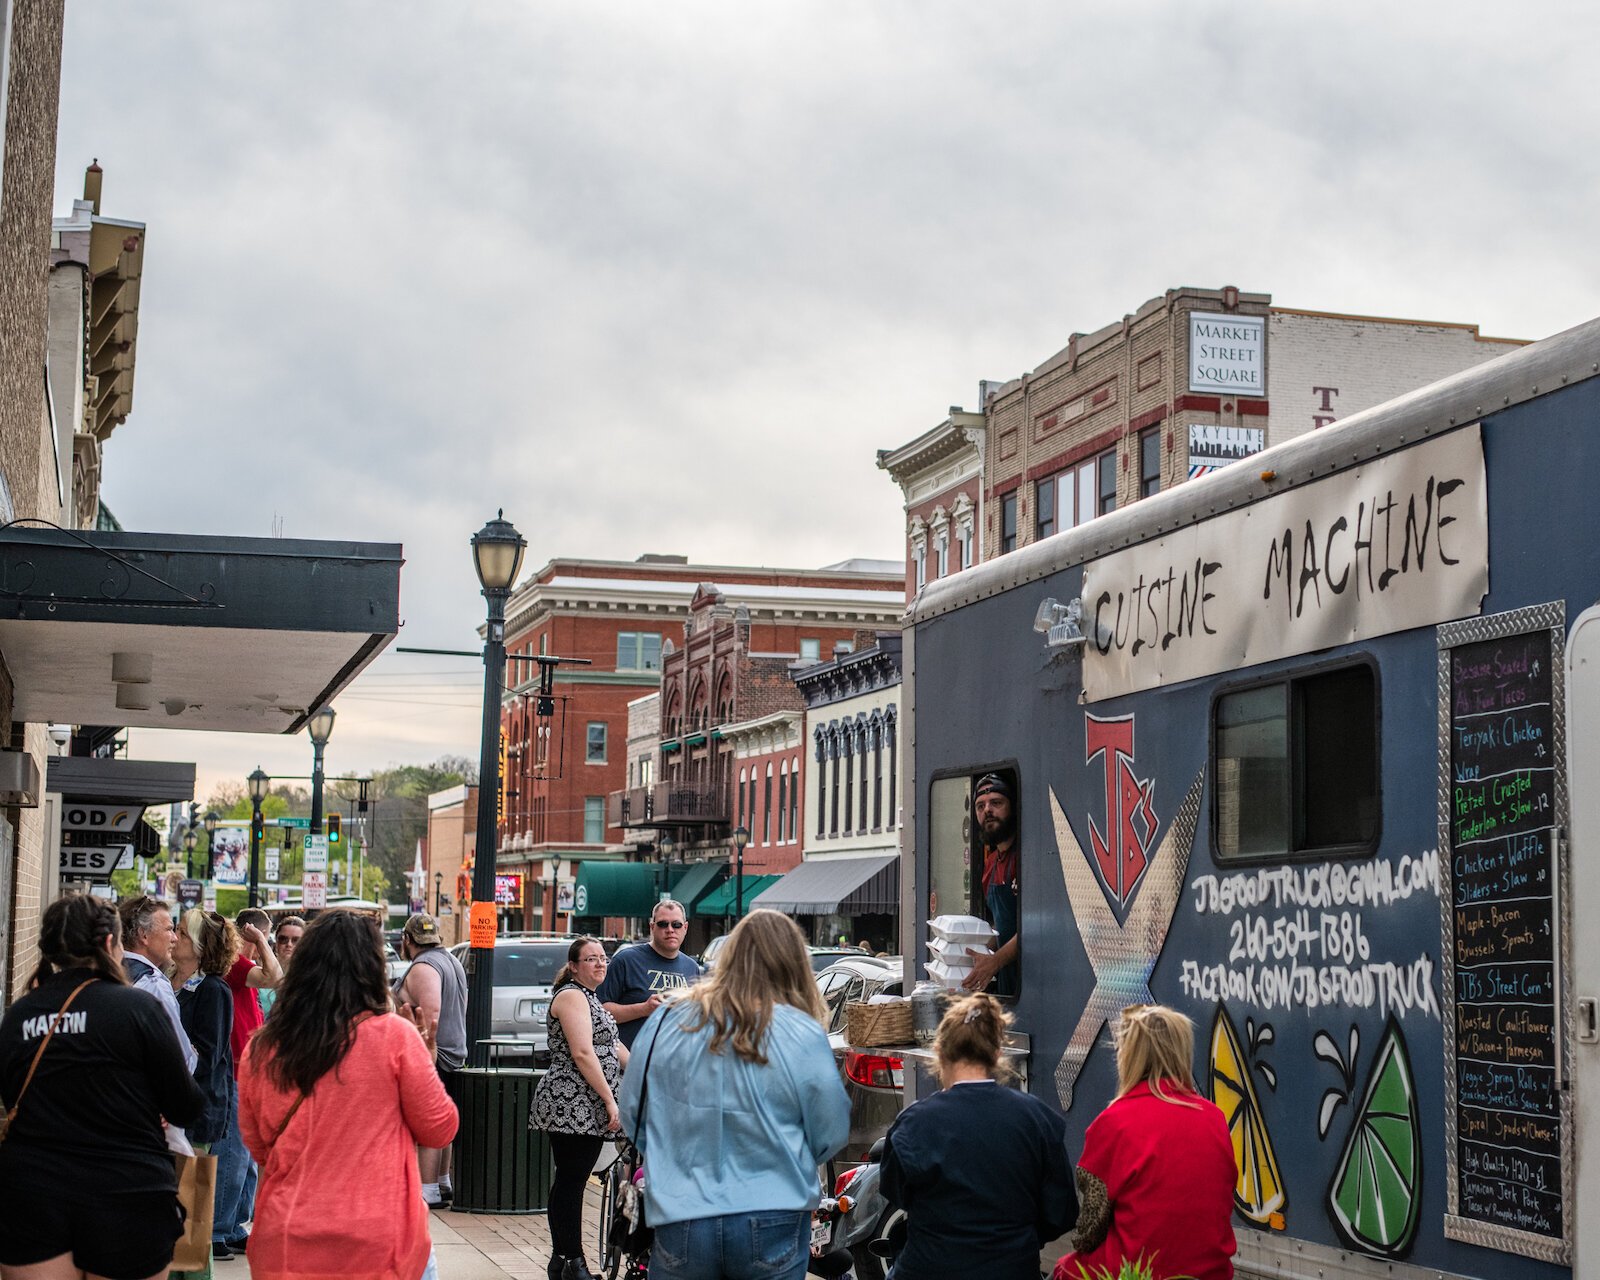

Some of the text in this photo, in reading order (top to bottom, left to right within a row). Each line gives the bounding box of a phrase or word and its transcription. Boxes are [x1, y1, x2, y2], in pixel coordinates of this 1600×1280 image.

[1195, 323, 1260, 341] MARKET
[1199, 344, 1255, 362] STREET
[1197, 365, 1258, 384] SQUARE
[1191, 424, 1263, 443] SKYLINE
[1095, 475, 1465, 657] CUISINE MACHINE
[1496, 682, 1526, 708] Tacos
[1455, 716, 1542, 755] Teriyaki Chicken
[1455, 761, 1480, 781] Wrap
[1492, 769, 1531, 805] Crusted
[61, 809, 107, 826] OD
[1508, 799, 1531, 822] Slaw
[1455, 854, 1496, 877] Chicken
[1507, 836, 1544, 867] Waffle
[1457, 882, 1491, 903] Sliders
[1502, 871, 1528, 892] Slaw
[1457, 939, 1495, 962] Brussels
[1501, 926, 1535, 955] Sprouts
[646, 969, 689, 991] ZELDA
[1487, 969, 1518, 998] Street
[1521, 973, 1542, 997] Corn
[1458, 1006, 1491, 1034] Roasted
[1497, 1008, 1549, 1035] Cauliflower
[1505, 1036, 1544, 1062] Parmesan
[1459, 1064, 1483, 1088] Veggie
[1486, 1065, 1515, 1094] Spring
[1517, 1067, 1537, 1091] Rolls
[1460, 1110, 1489, 1137] Spiral
[1495, 1113, 1521, 1140] Spuds
[1482, 1151, 1509, 1177] Quality
[1461, 1173, 1495, 1196] Jamaican
[1498, 1182, 1517, 1204] Jerk
[1522, 1188, 1540, 1210] Pork
[1464, 1196, 1483, 1213] Tacos
